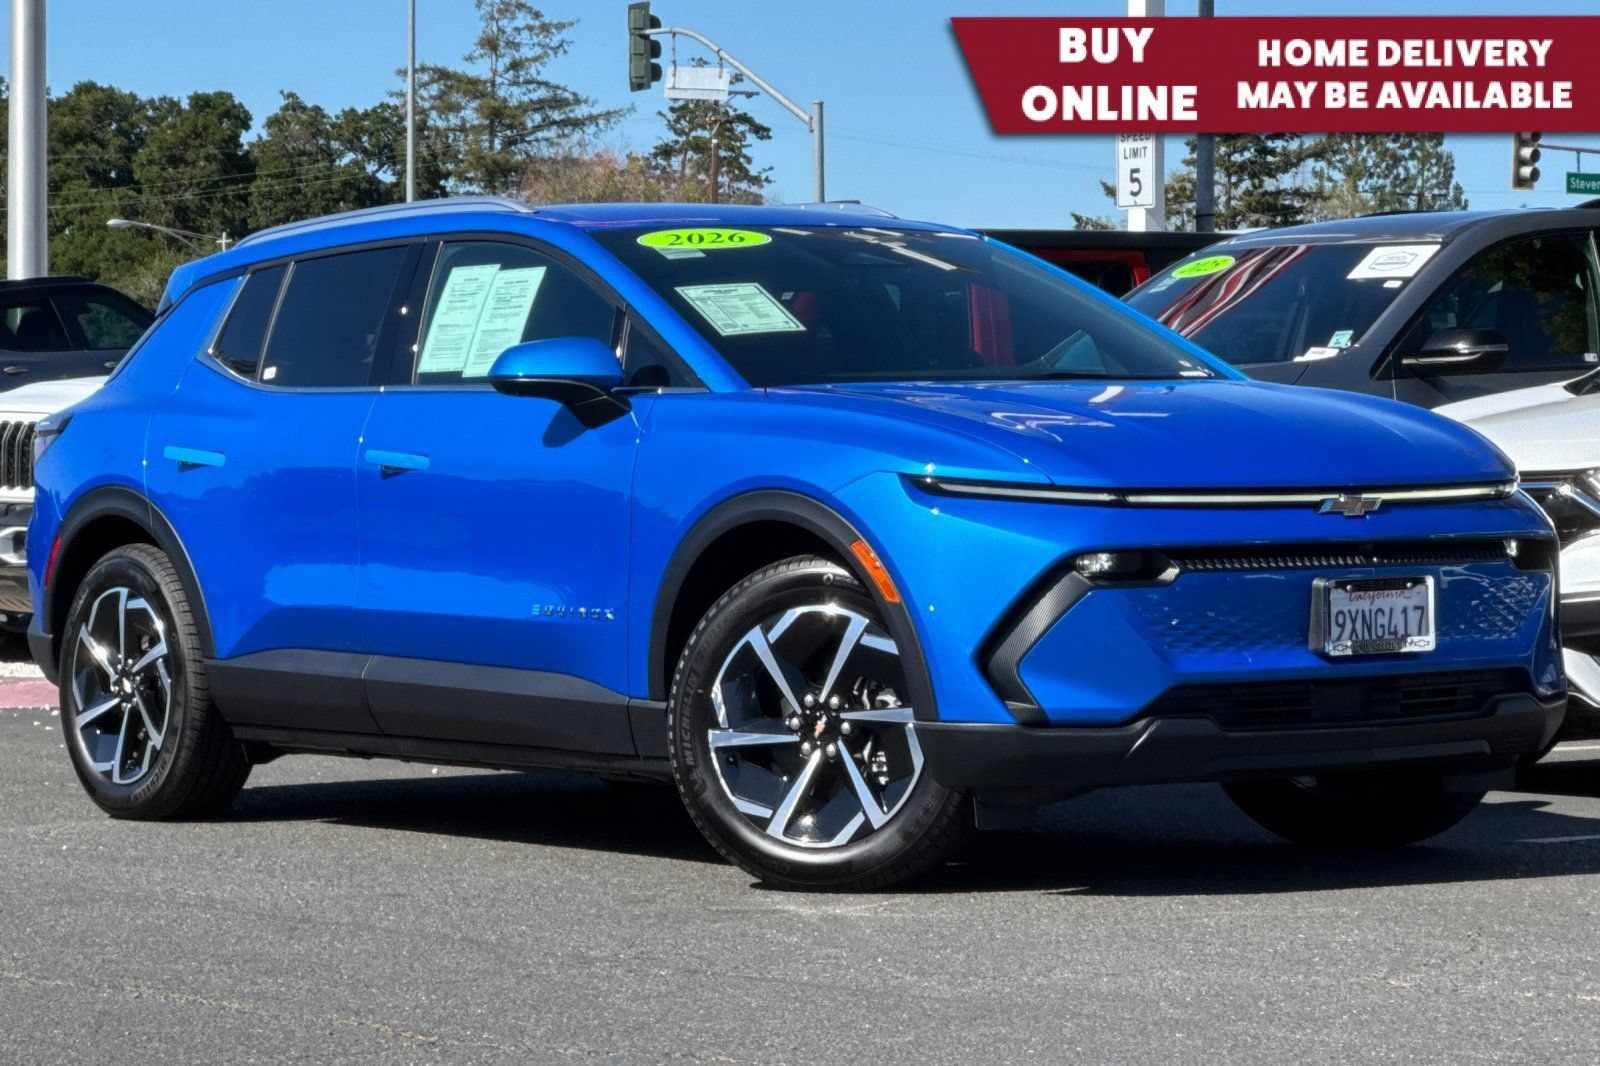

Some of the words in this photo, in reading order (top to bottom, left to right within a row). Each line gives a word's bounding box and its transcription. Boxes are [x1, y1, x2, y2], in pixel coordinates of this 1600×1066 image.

[1120, 132, 1151, 142] SPEED
[1123, 146, 1148, 160] LIMIT
[1129, 168, 1142, 197] 5
[667, 232, 745, 246] 2026
[1348, 590, 1413, 605] California
[1334, 605, 1425, 643] 9XNG417
[680, 670, 700, 766] MICHELIN
